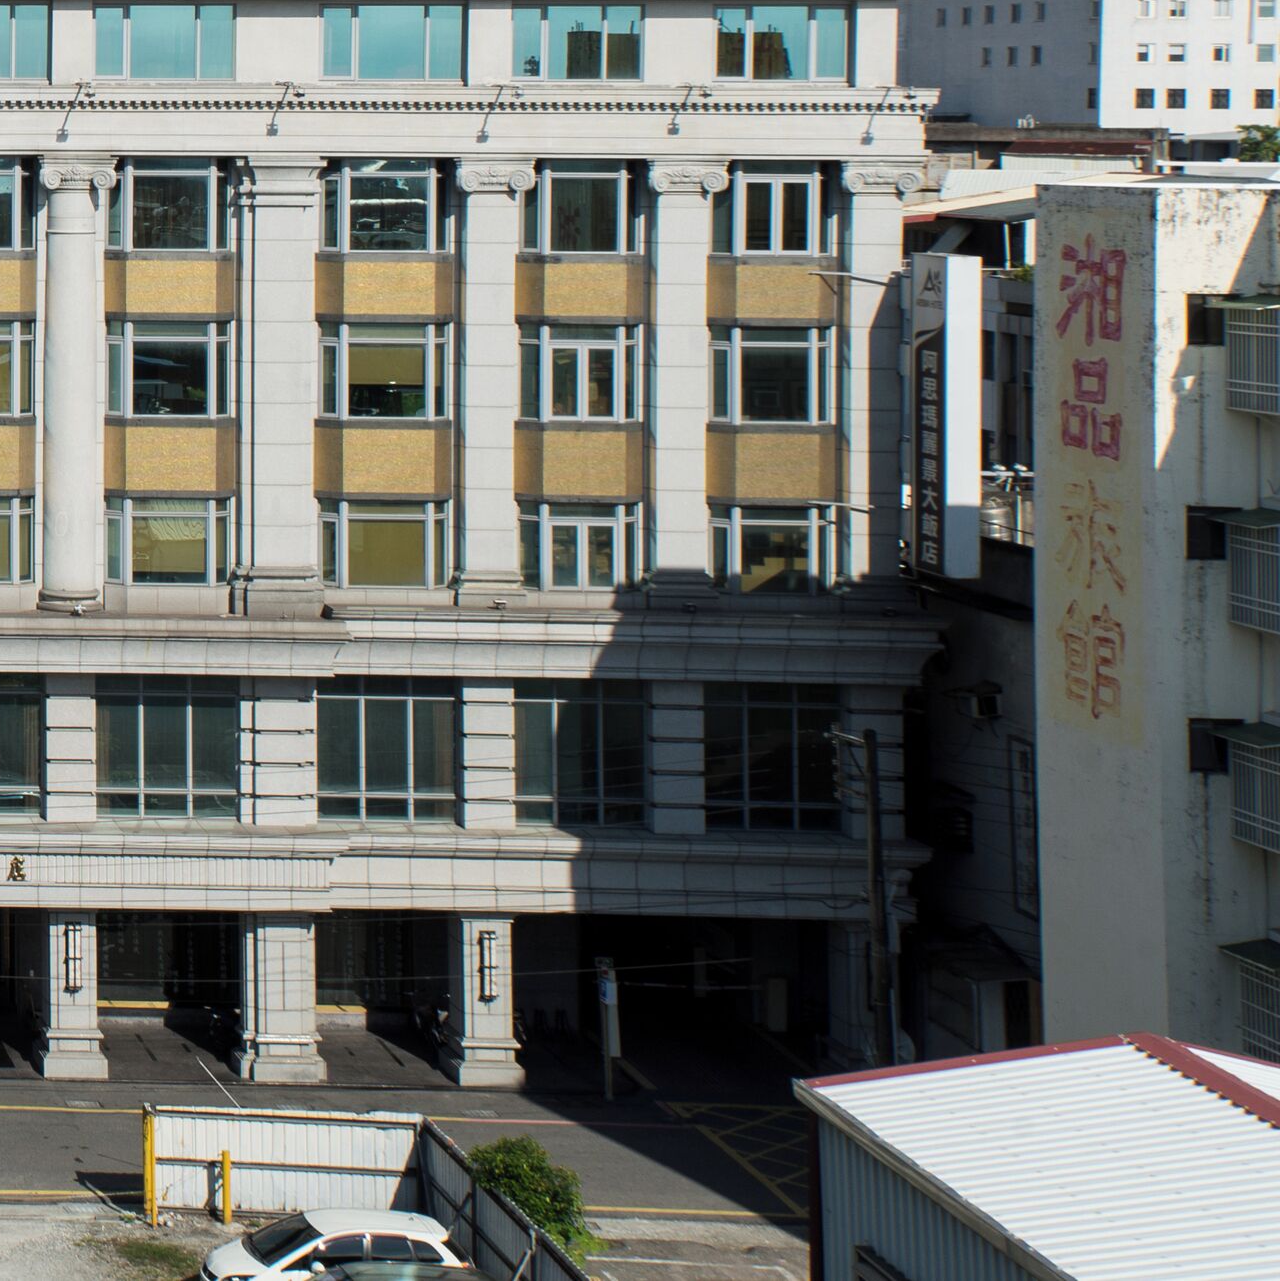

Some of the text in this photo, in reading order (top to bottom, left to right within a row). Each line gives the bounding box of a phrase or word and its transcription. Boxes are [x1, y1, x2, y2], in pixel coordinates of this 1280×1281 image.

[921, 349, 939, 566] 阿思瑪麗景大飯店
